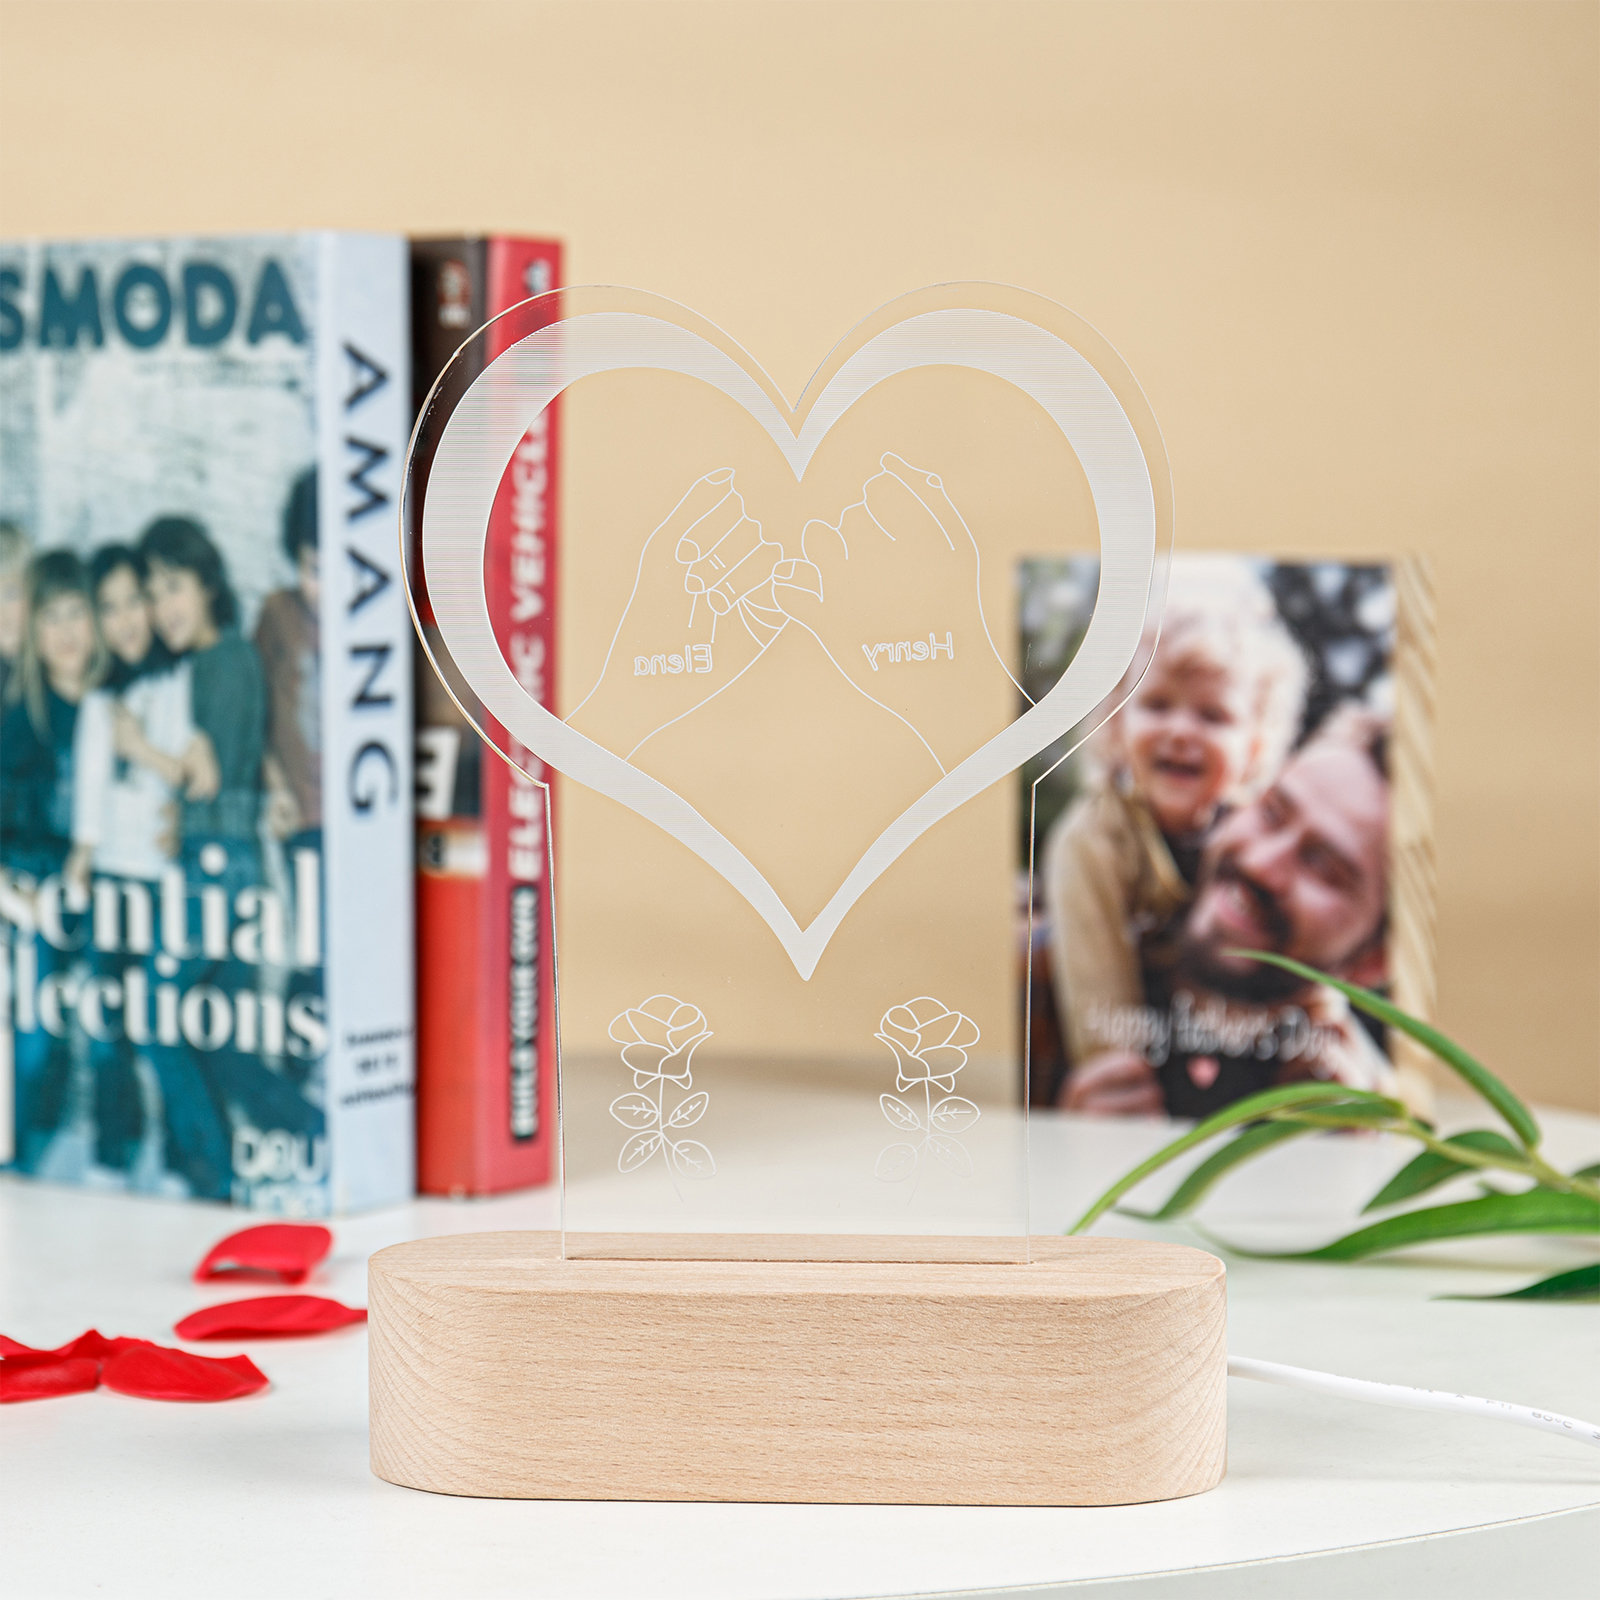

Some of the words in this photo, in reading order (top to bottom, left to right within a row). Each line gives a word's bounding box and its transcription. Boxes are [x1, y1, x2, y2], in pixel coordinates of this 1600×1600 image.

[0, 256, 307, 352] SMODA
[343, 341, 398, 815] AMANG
[508, 634, 546, 880] ELECIC
